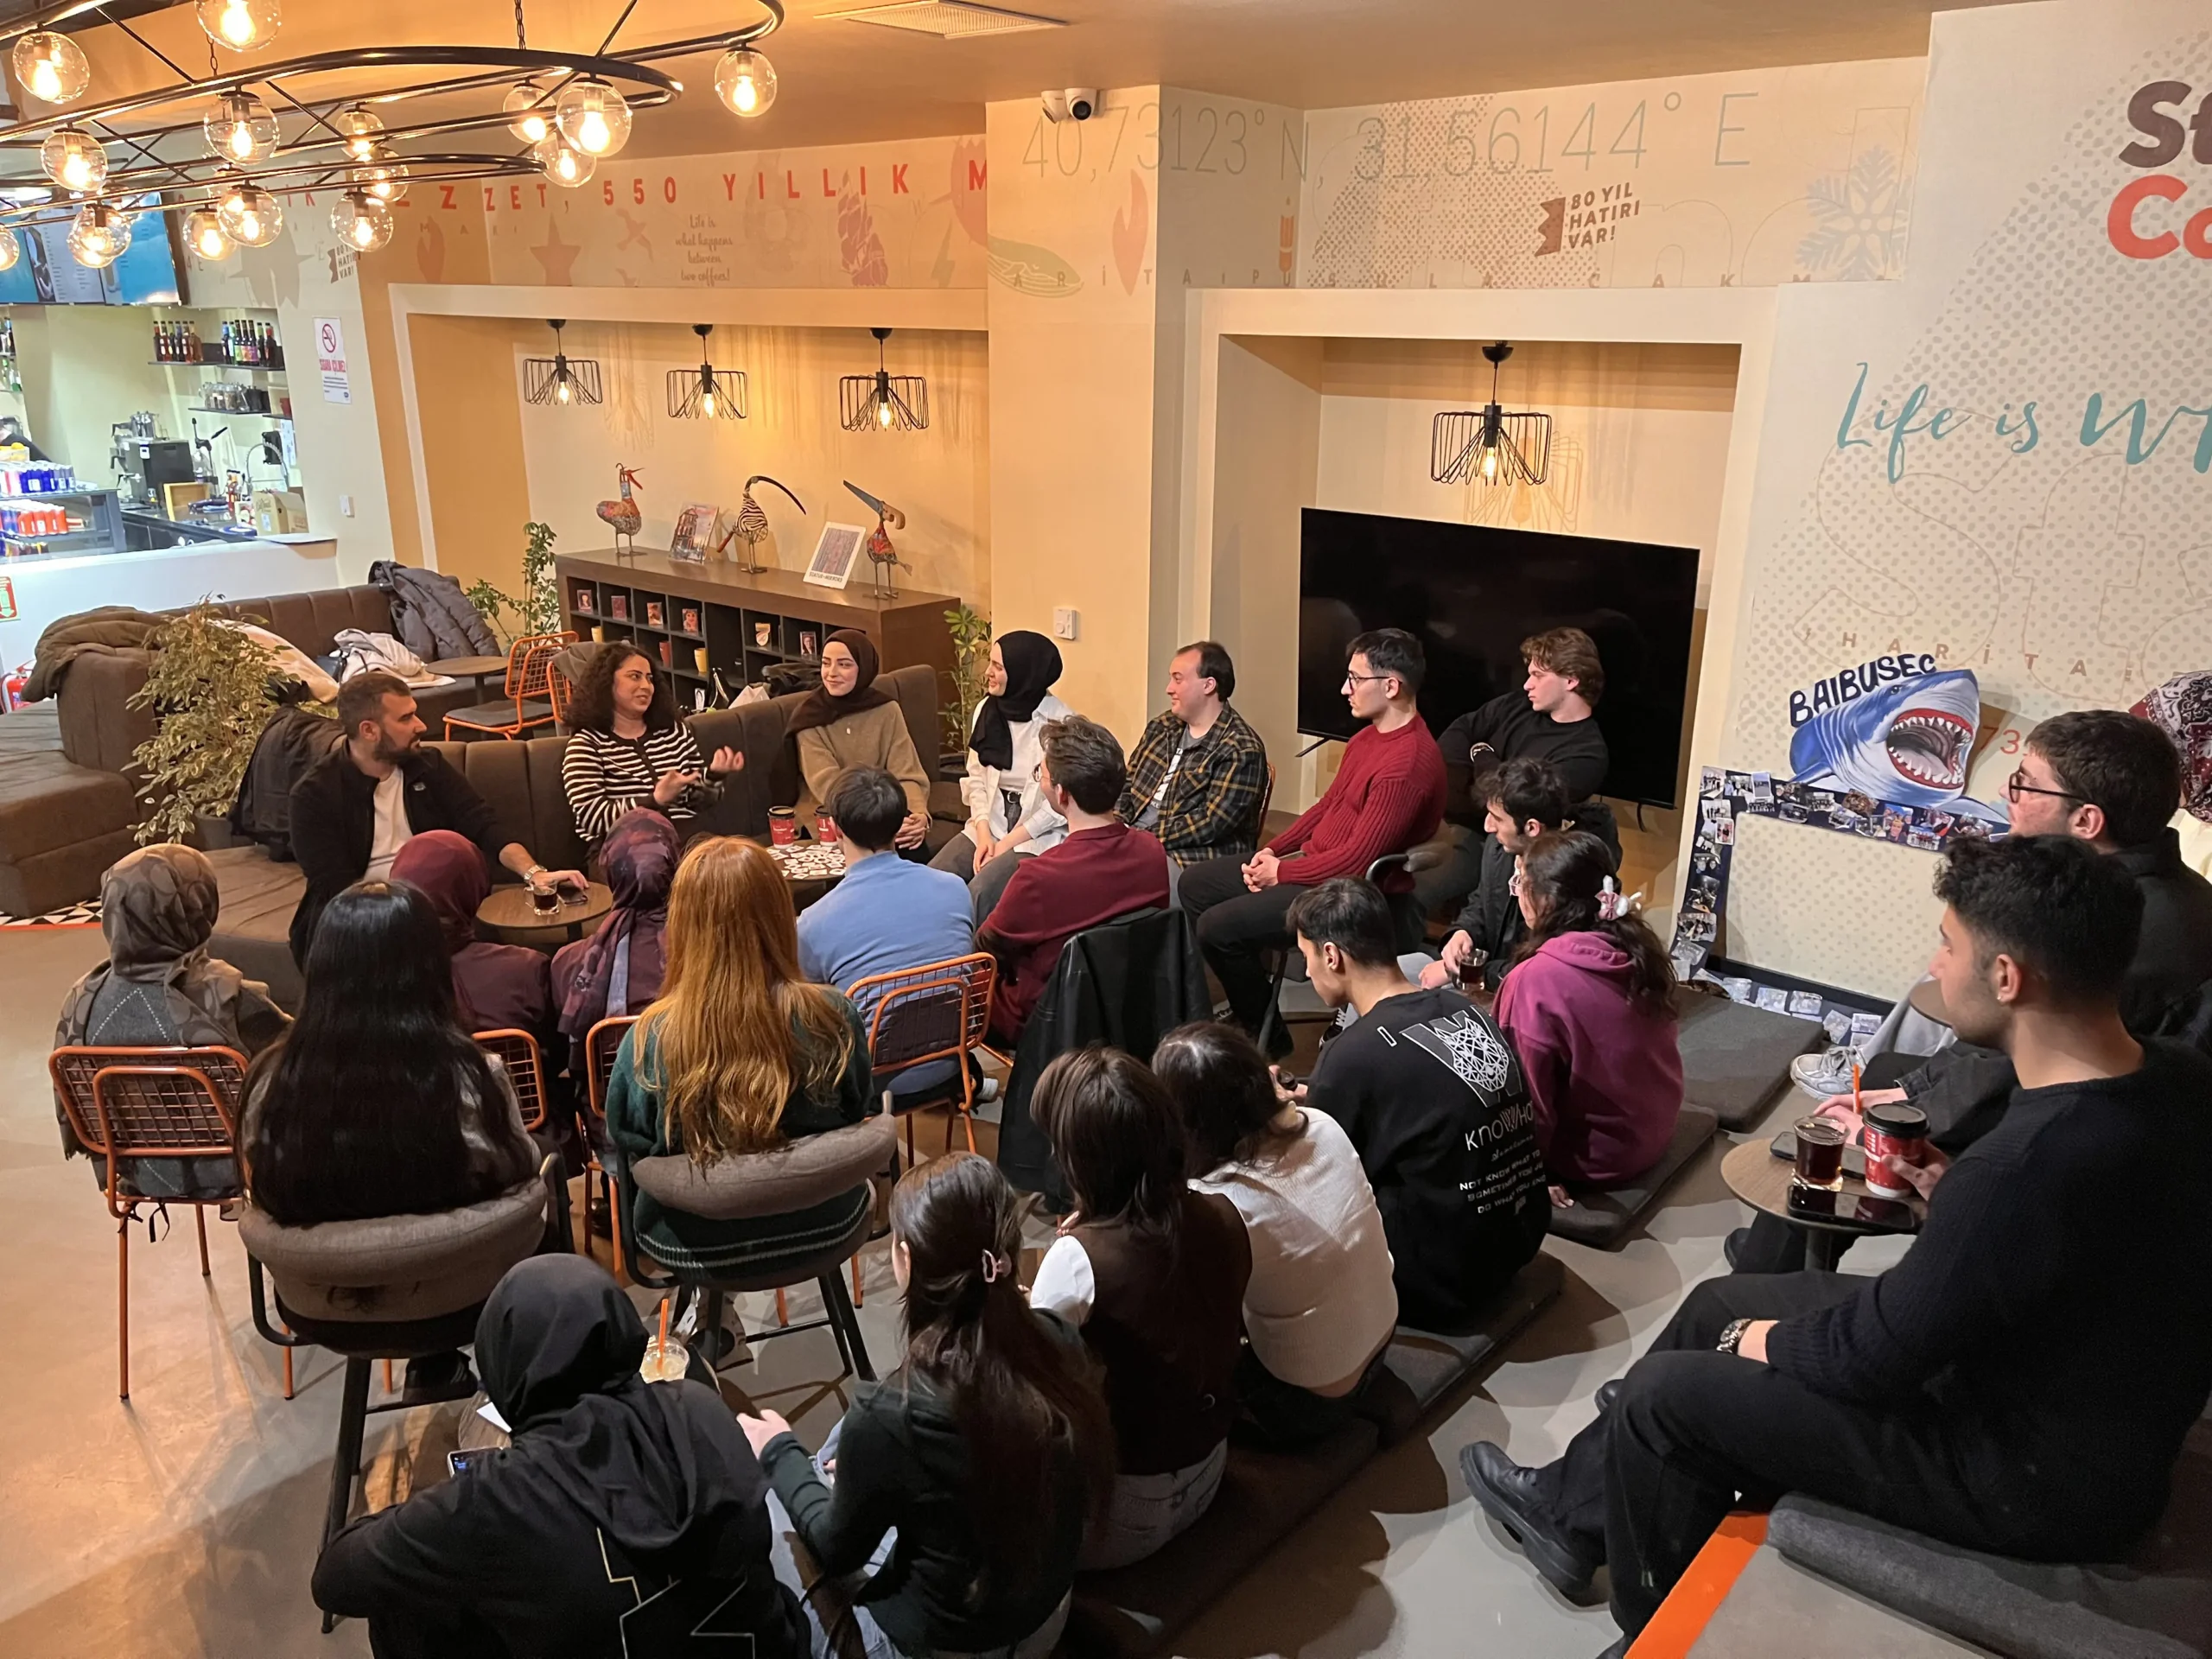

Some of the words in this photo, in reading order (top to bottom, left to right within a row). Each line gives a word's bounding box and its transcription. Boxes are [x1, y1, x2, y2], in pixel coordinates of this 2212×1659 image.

[1714, 92, 1759, 167] E
[603, 175, 677, 207] 550
[722, 163, 909, 201] YILLIK
[1602, 181, 1633, 203] YIL
[1569, 200, 1640, 231] HATIRI
[1568, 226, 1616, 249] VAR!
[1837, 362, 1973, 485] Life
[1995, 401, 2039, 454] is
[1789, 653, 1936, 728] BAIBUSEC
[1459, 1179, 1482, 1191] NOT
